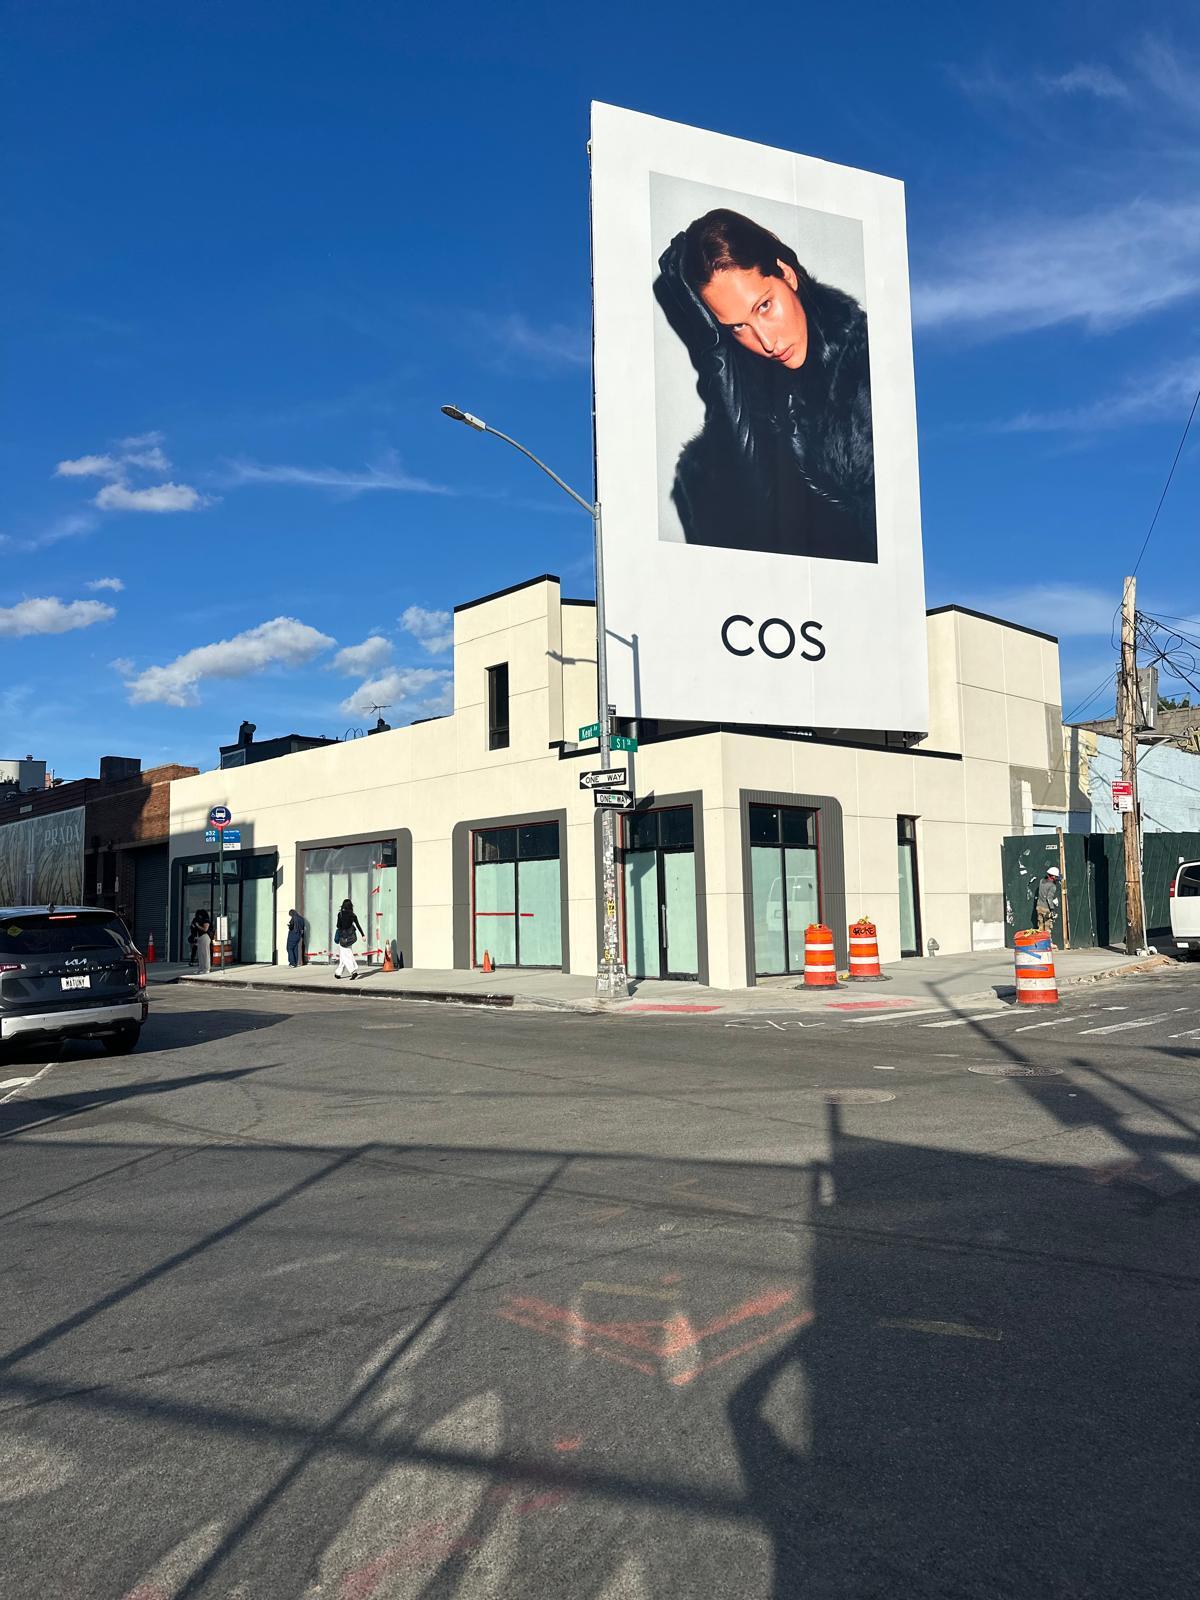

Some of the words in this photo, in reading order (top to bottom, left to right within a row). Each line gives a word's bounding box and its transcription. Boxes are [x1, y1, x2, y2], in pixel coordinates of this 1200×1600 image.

[721, 614, 826, 662] COS
[582, 726, 593, 739] Kent
[616, 738, 621, 749] S
[585, 775, 600, 784] ONE
[606, 773, 622, 782] WAY
[599, 794, 612, 803] ONE
[44, 824, 81, 848] PRADA
